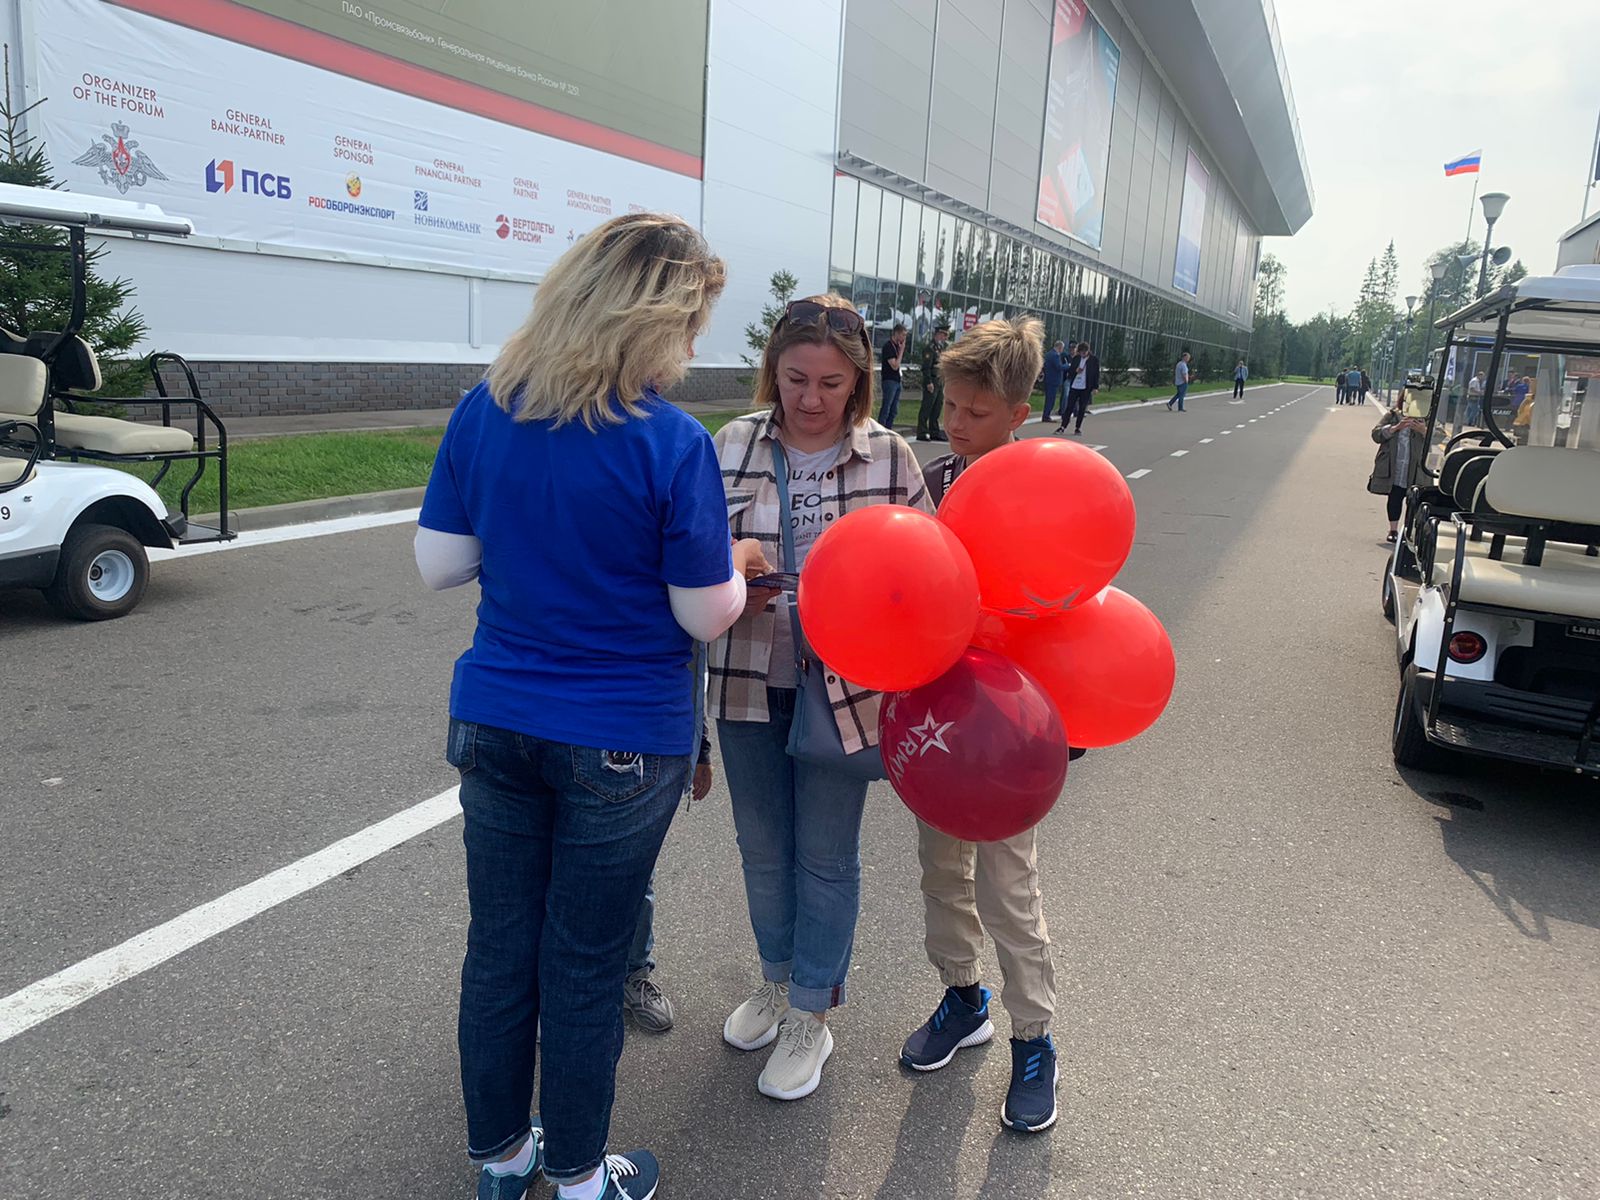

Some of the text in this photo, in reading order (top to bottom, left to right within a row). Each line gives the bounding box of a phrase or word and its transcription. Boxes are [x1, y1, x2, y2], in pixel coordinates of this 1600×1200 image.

[342, 1, 363, 18] ПАО
[82, 72, 157, 102] ORGANIZER
[73, 86, 165, 119] OF THE FORUM
[226, 108, 273, 130] GENERAL
[211, 119, 286, 146] BANK-PARTNER
[334, 135, 373, 154] GENERAL
[333, 147, 375, 166] SPONSOR
[433, 158, 465, 174] GENERAL
[241, 168, 292, 200] ПСБ
[414, 165, 482, 188] FINANCIAL PARTNER
[512, 176, 540, 191] GENERAL
[512, 186, 538, 200] PARTNER
[566, 189, 612, 206] GENERAL PARTNER
[308, 196, 395, 220] РОСОБОРОНЭКСПОРТ
[566, 199, 592, 212] AVIATION
[414, 213, 482, 234] НОВИКОМБАНК
[512, 217, 555, 234] ВЕРТОЛЕТЫ
[512, 229, 542, 244] РОССИИ
